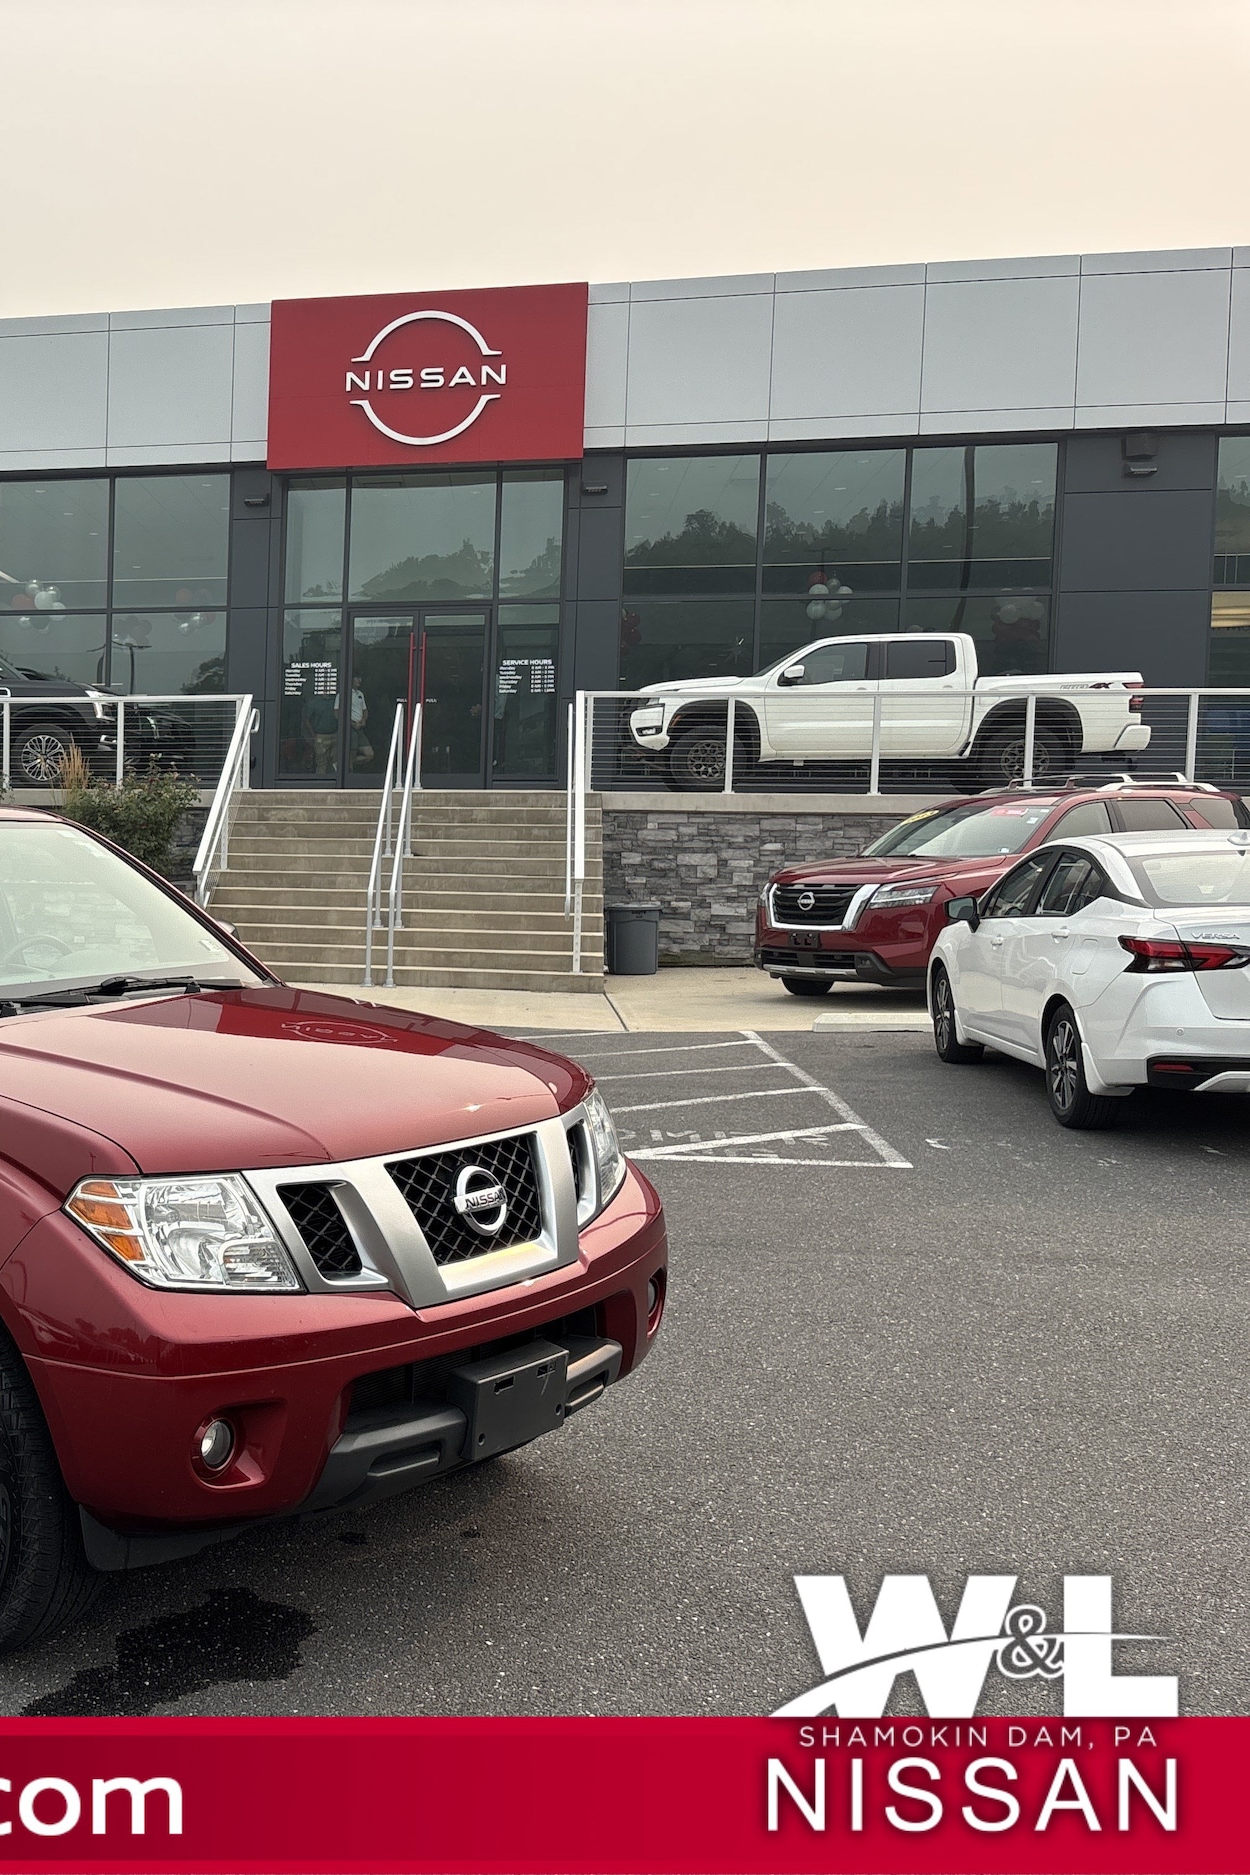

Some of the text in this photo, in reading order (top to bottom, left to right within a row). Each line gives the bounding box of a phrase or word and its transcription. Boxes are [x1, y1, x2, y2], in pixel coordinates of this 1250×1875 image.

[345, 364, 507, 392] NISSAN
[1191, 932, 1240, 940] VERSA
[465, 1189, 505, 1210] NISSAN
